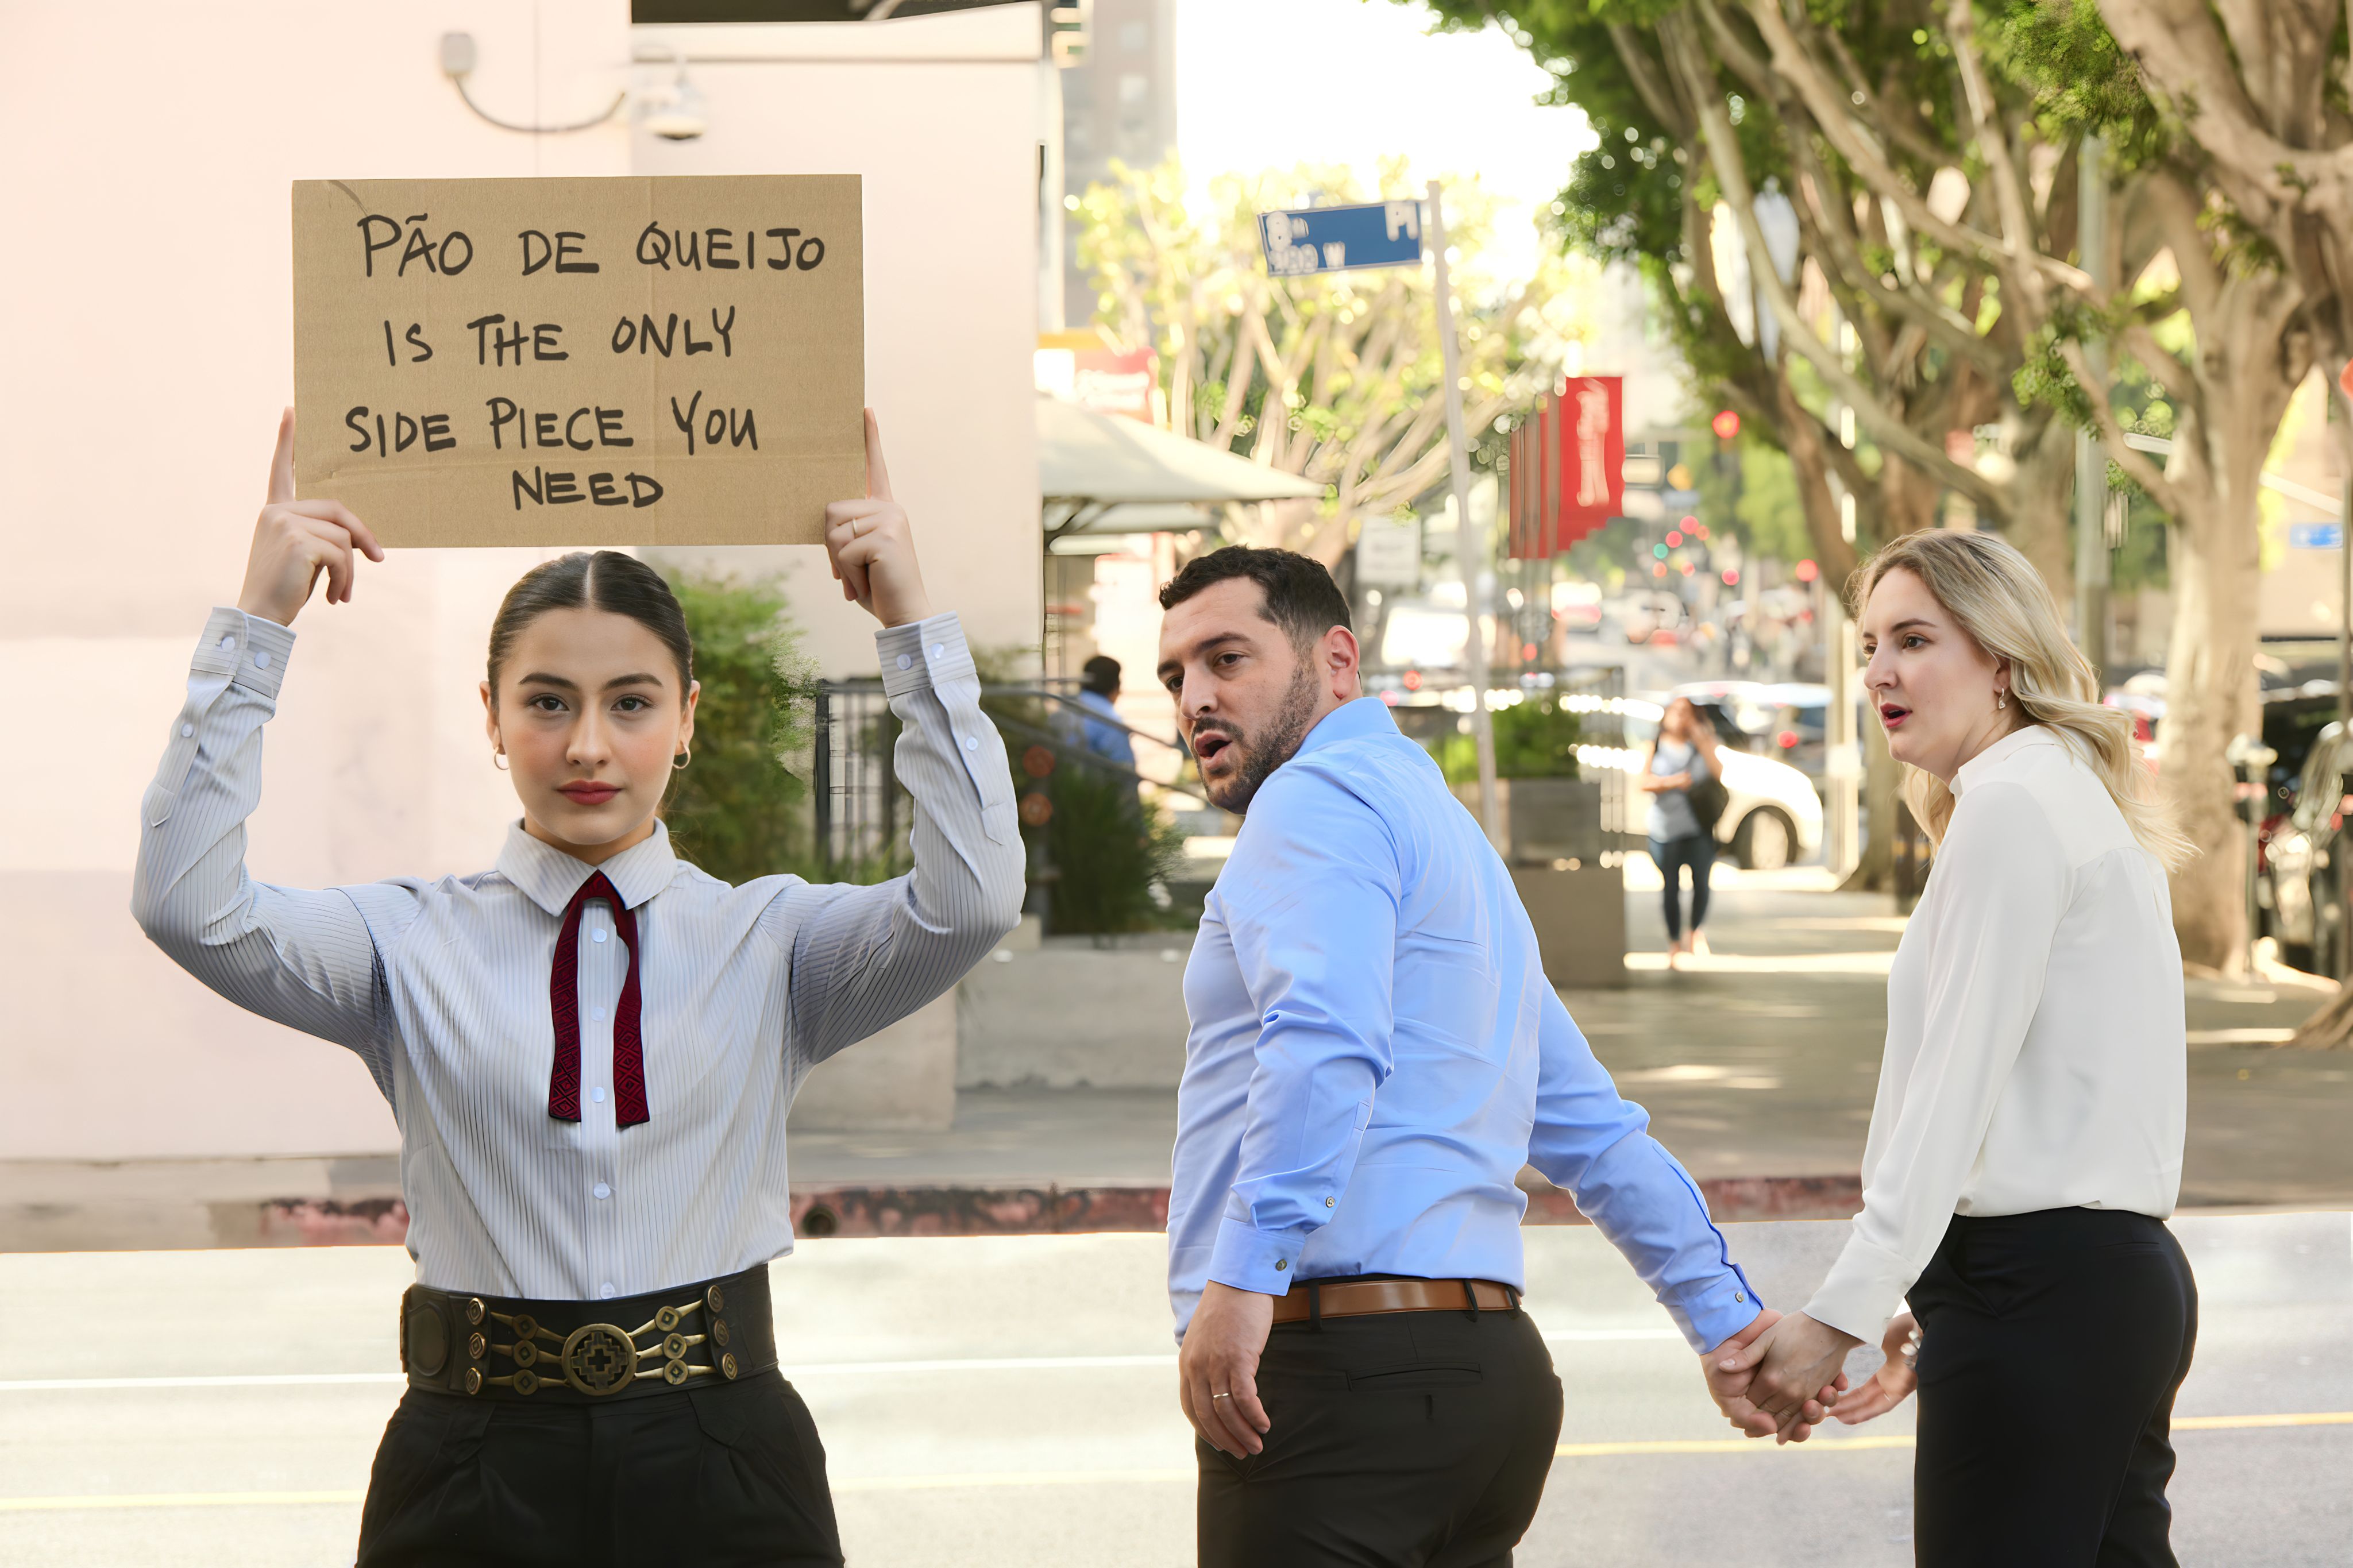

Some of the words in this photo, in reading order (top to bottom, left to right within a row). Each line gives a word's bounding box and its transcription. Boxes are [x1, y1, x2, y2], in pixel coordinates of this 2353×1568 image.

[357, 213, 473, 277] PÃO
[518, 230, 600, 276] DE
[636, 221, 825, 272] QUEIJO
[384, 320, 433, 366] IS
[466, 314, 569, 367] THE
[611, 305, 735, 358] ONLY
[345, 406, 457, 458] SIDE
[485, 397, 634, 451] PIECE
[670, 390, 758, 456] YOU
[512, 466, 664, 511] NEED
